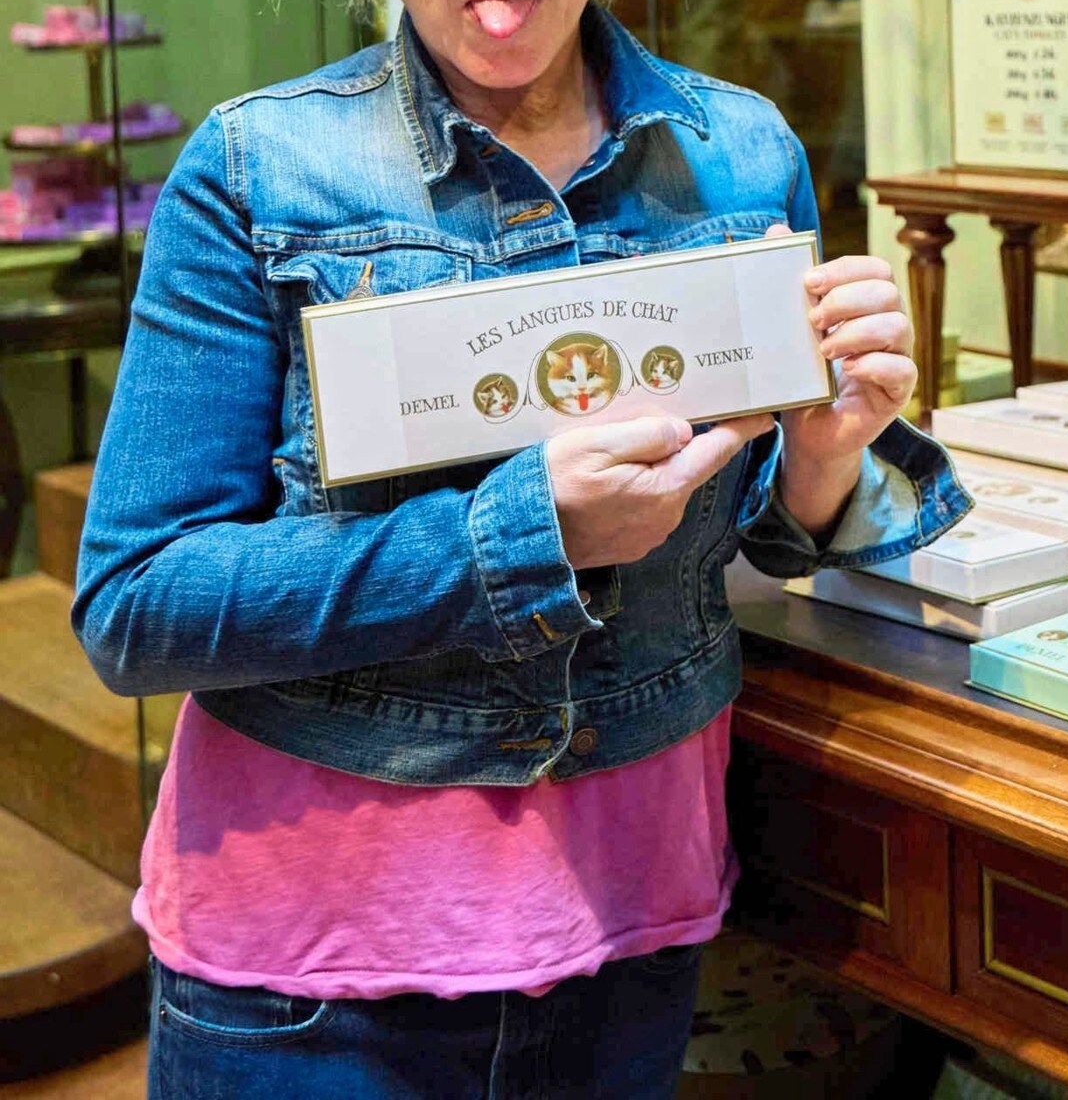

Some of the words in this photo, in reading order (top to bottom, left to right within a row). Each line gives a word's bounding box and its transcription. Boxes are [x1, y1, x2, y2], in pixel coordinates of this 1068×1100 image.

[466, 327, 503, 357] LES
[506, 301, 595, 337] LANGUES
[602, 300, 627, 318] DE
[632, 301, 679, 324] CHAT
[400, 393, 460, 417] DEMEL
[695, 346, 755, 369] VIENNE
